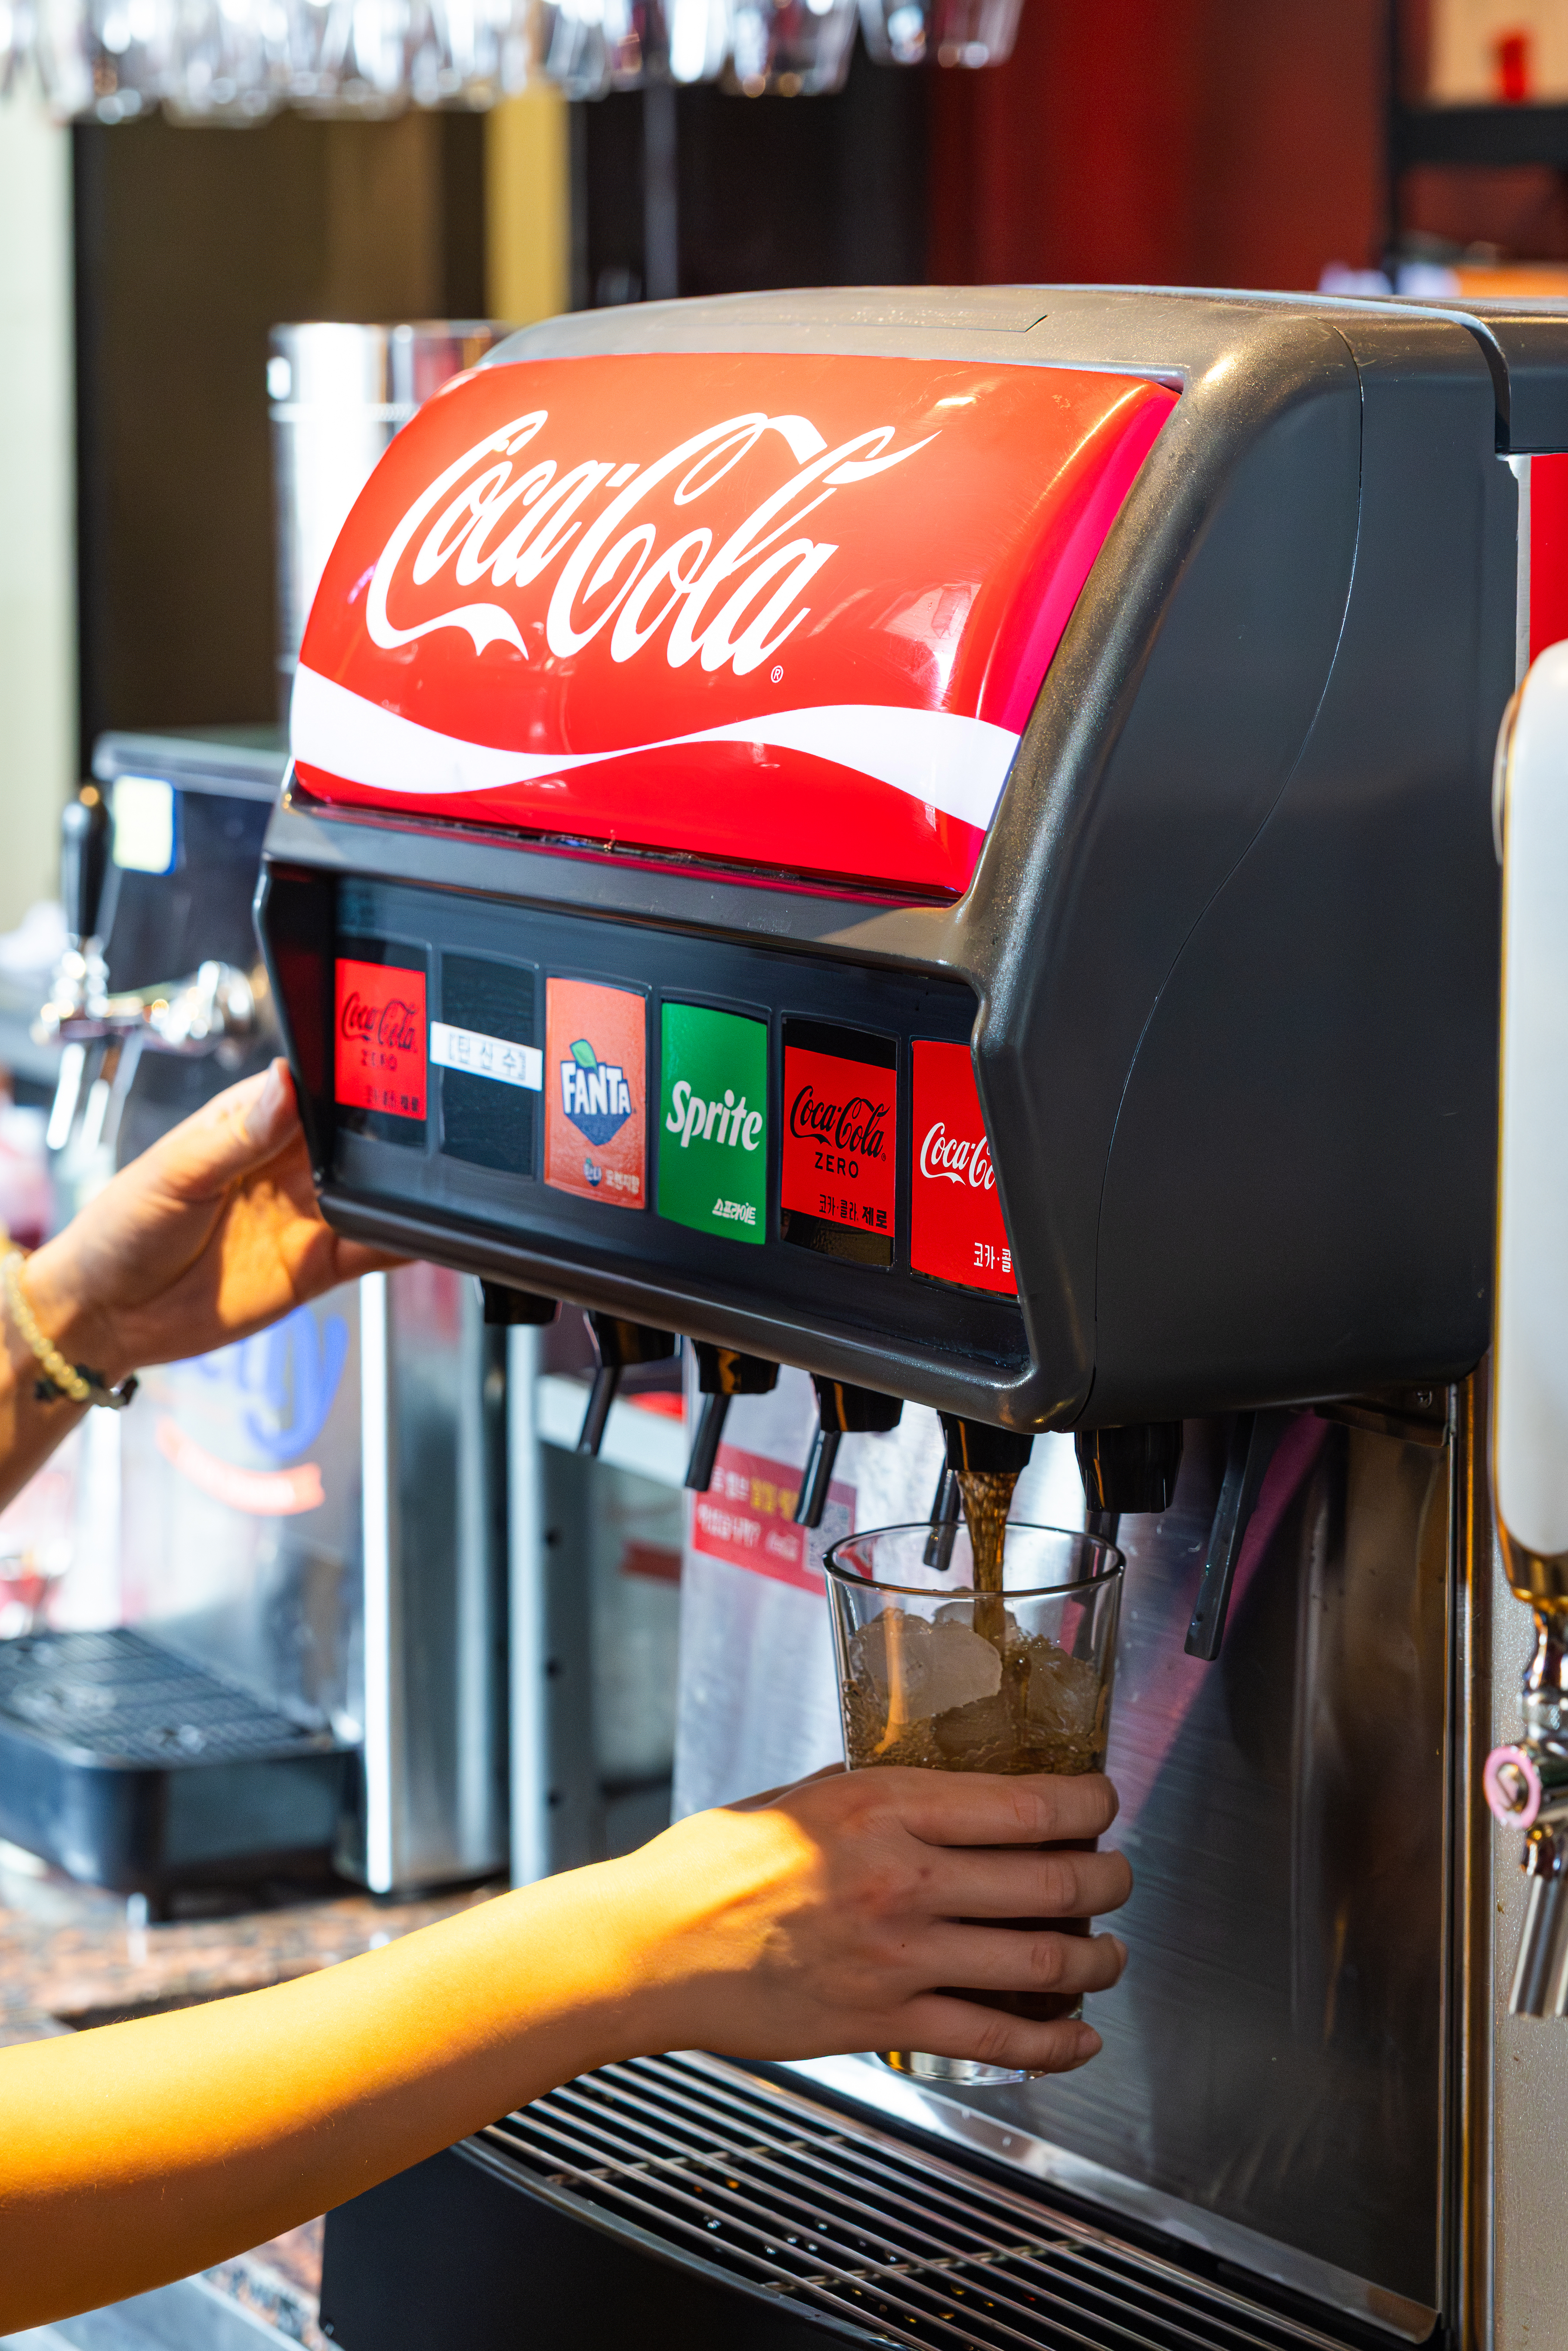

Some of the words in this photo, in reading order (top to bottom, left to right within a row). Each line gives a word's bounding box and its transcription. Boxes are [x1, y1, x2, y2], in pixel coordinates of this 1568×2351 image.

[366, 410, 942, 676] Coca-Cola
[560, 1061, 632, 1115] FANTA
[666, 1080, 763, 1151] Sprite
[790, 1085, 891, 1159] Coca-Cola
[815, 1151, 859, 1179] ZERO
[920, 1122, 996, 1190] Coca-Co
[712, 1198, 756, 1226] 스프라이트
[861, 1206, 888, 1229] 제로
[973, 1242, 1012, 1273] 코카·콜
